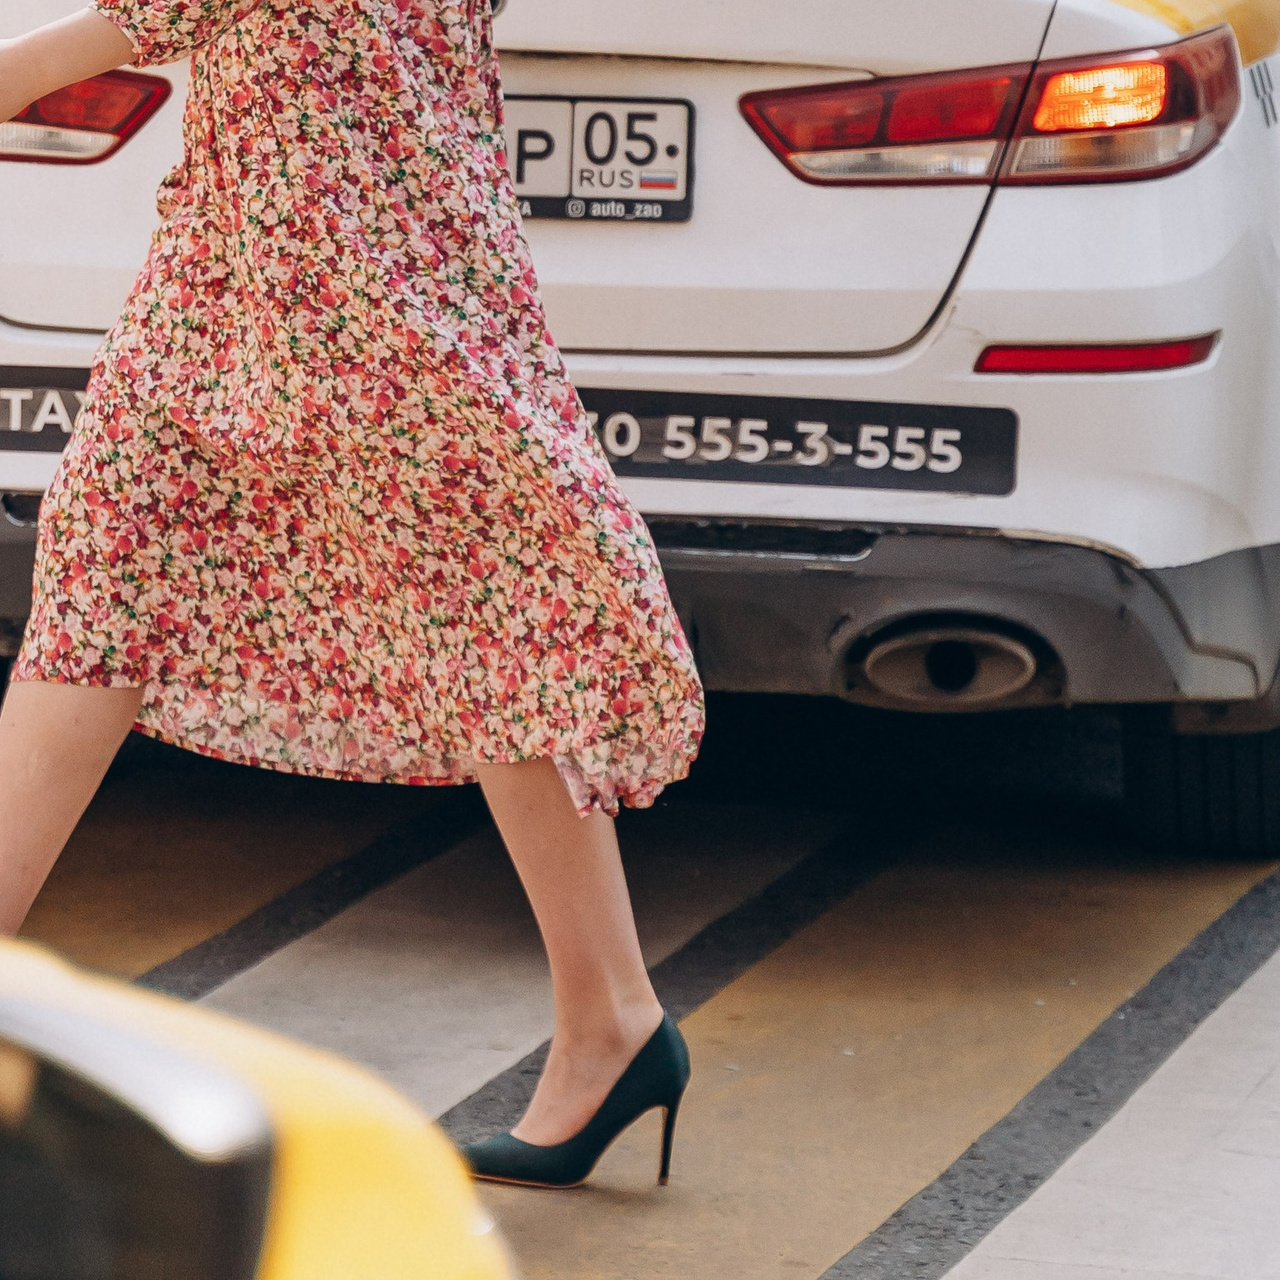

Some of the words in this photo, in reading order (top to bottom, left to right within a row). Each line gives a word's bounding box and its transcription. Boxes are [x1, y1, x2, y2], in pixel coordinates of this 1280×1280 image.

[584, 111, 658, 166] 05
[579, 169, 634, 189] RUS
[585, 411, 641, 457] 0
[662, 414, 963, 474] 555-3-555
